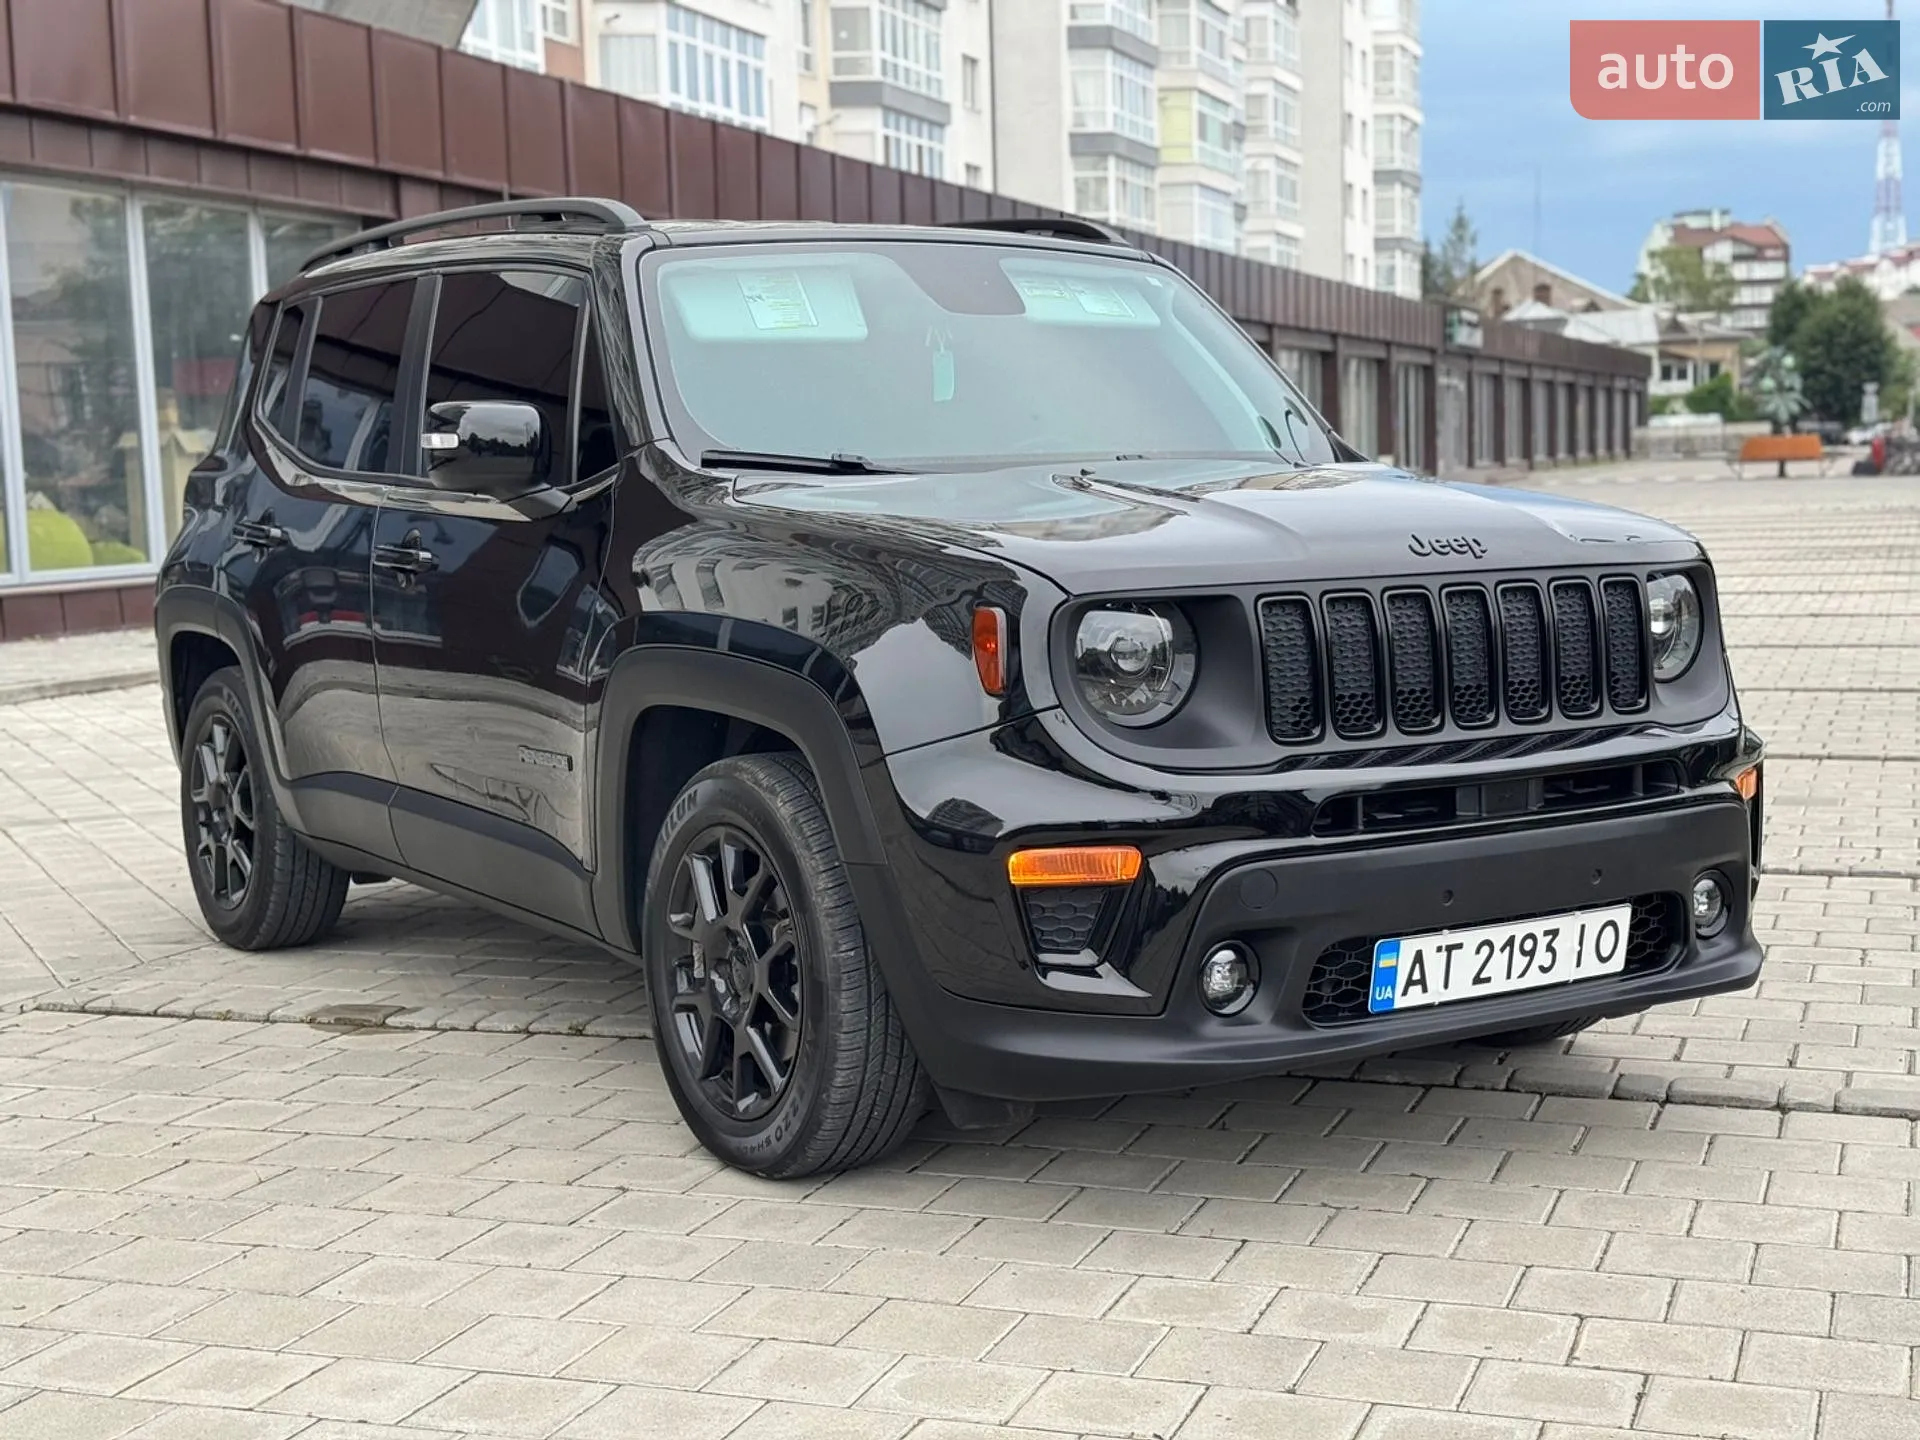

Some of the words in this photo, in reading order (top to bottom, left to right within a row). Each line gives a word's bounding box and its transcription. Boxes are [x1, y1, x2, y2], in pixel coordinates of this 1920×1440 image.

[1407, 533, 1488, 559] Jeep
[1401, 942, 1463, 997] AT
[1472, 928, 1560, 986] 2193
[1575, 919, 1620, 968] IO
[1375, 986, 1393, 1001] UA
